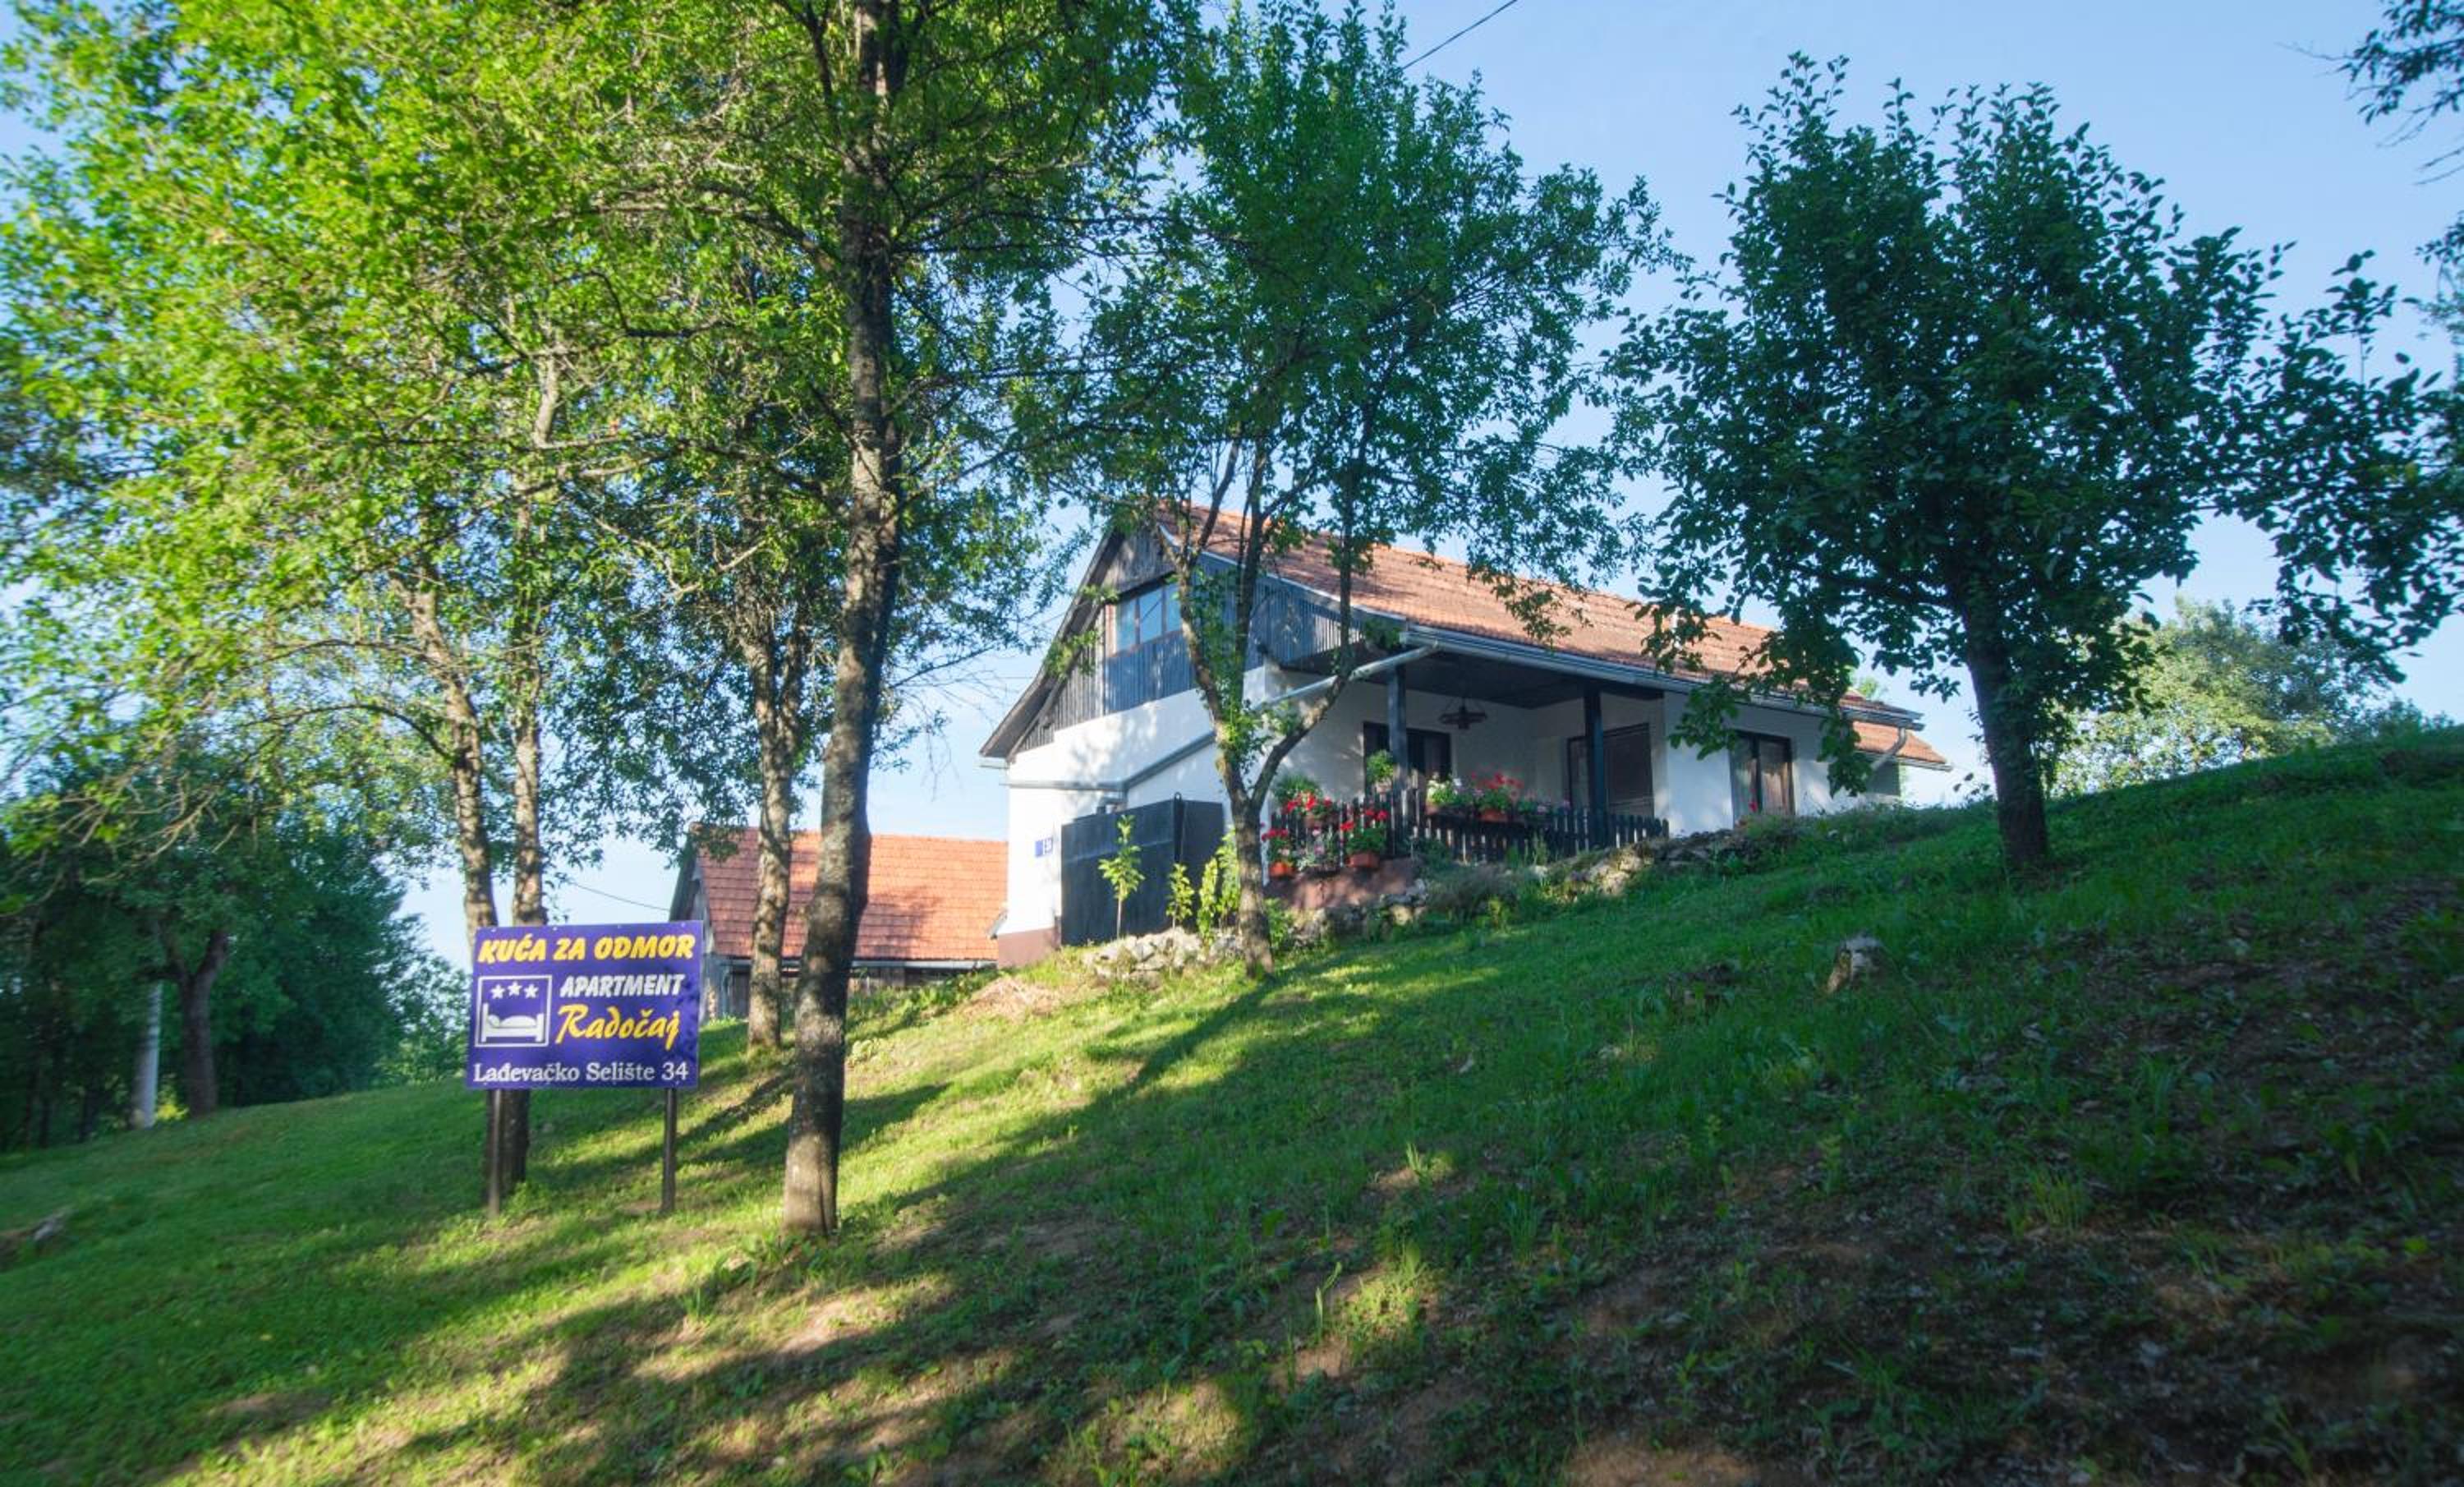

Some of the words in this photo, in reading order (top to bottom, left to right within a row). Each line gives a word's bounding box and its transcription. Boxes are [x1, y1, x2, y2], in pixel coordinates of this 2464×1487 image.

[477, 933, 546, 964] KUĆA
[553, 937, 586, 960] ZA
[594, 934, 696, 960] ODMOR
[559, 974, 686, 997] APARTMENT
[554, 1003, 680, 1051] Radočaj
[586, 1061, 655, 1081] Selište
[661, 1061, 689, 1080] 34
